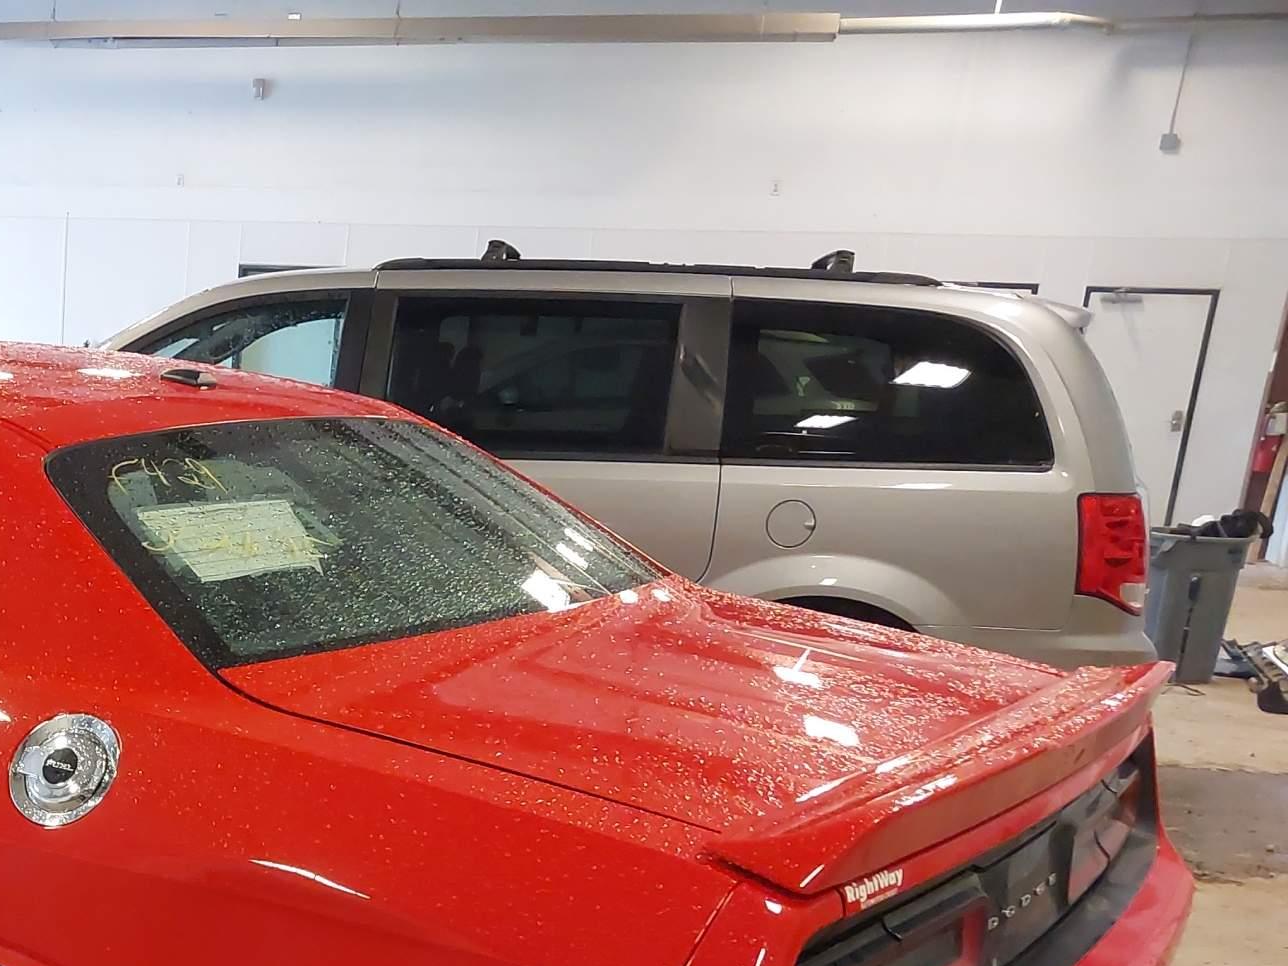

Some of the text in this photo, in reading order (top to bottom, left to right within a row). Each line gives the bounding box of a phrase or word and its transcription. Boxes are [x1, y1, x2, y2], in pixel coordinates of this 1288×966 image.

[45, 758, 74, 772] FUEL
[844, 868, 903, 903] RightWay
[987, 872, 1057, 931] DODGE
